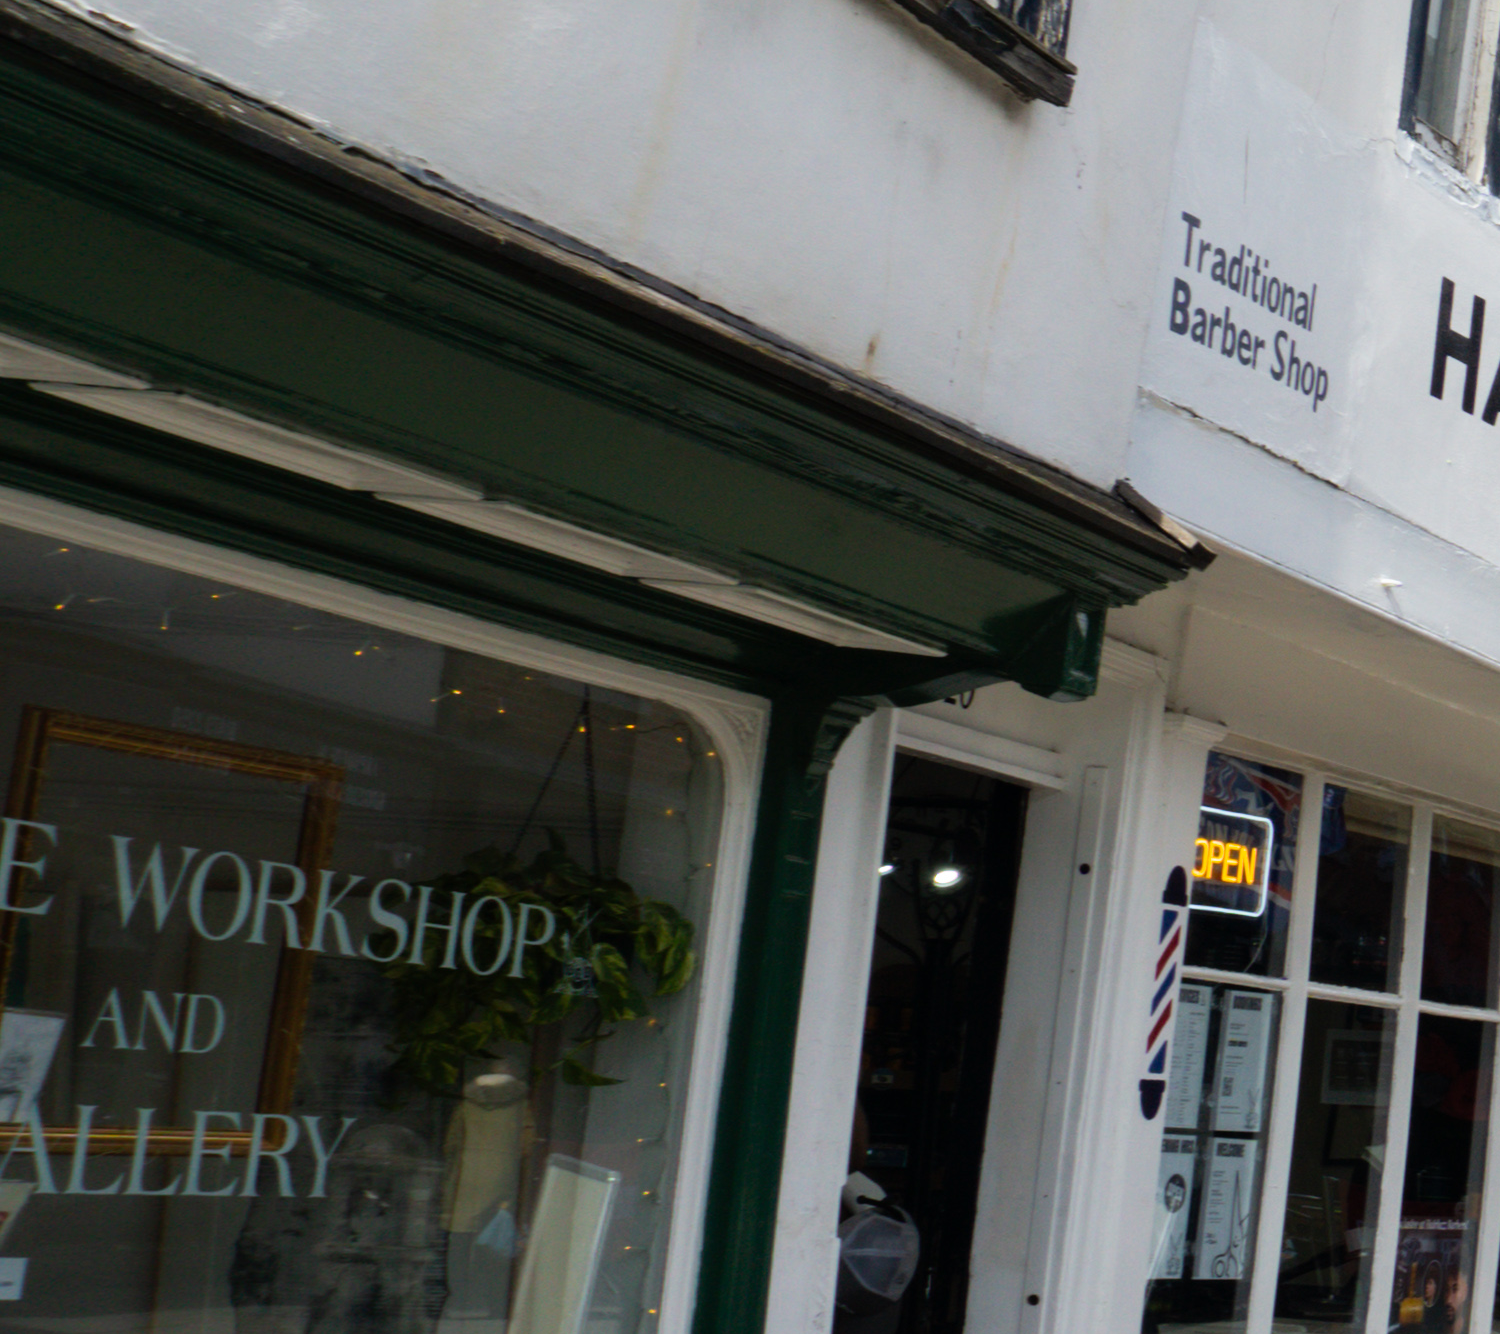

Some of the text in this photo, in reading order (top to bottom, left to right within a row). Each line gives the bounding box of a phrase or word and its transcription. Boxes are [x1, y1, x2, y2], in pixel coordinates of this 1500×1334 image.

[1181, 211, 1317, 333] Traditional
[1169, 276, 1329, 413] Barber Shop
[111, 834, 556, 978] WORKSHOP
[1191, 837, 1257, 885] OPEN
[81, 989, 227, 1054] AND
